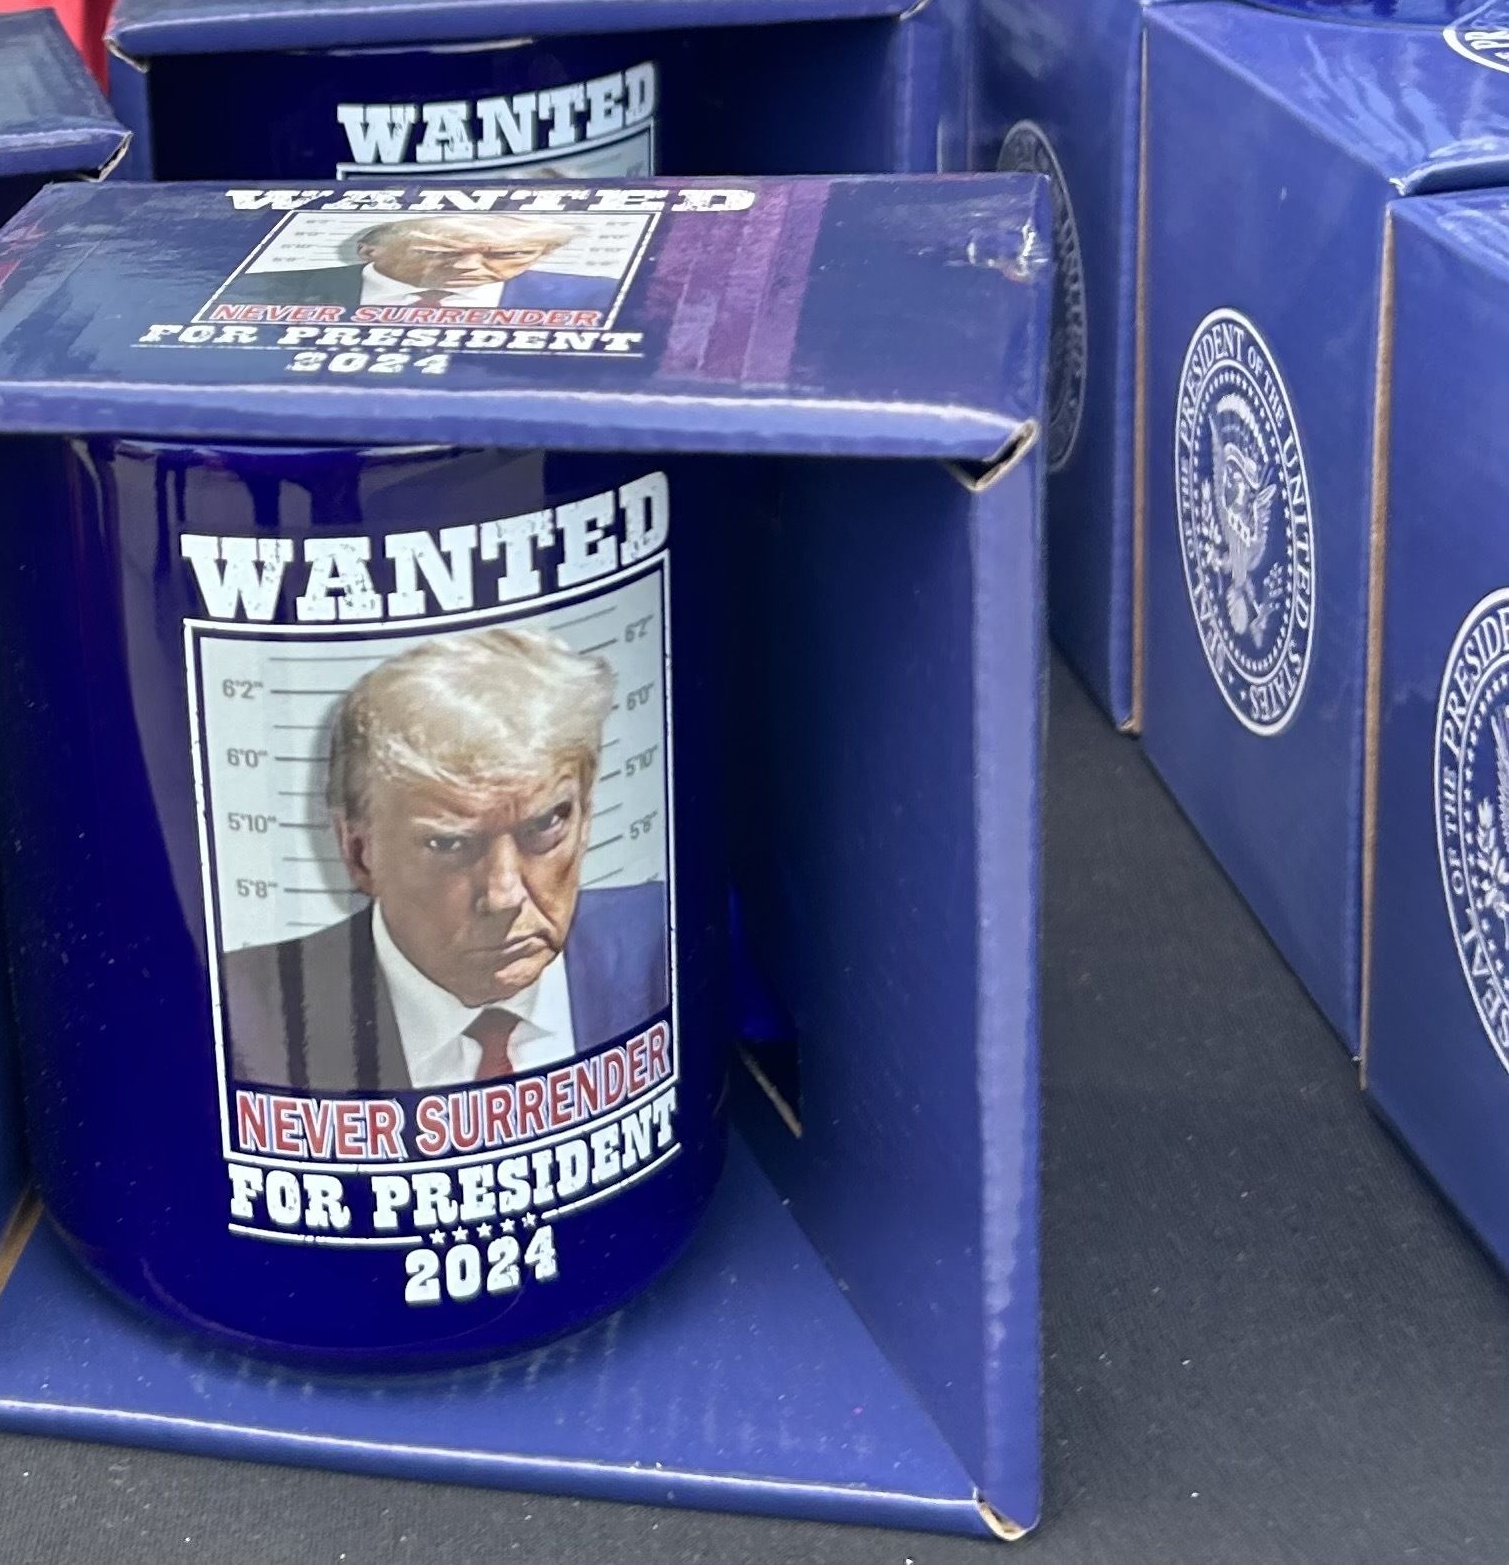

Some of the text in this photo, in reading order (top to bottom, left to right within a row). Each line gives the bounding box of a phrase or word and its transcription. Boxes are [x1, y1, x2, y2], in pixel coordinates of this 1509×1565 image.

[336, 60, 657, 165] WANTED
[225, 188, 756, 212] WANTED
[140, 323, 644, 354] FOR PRESIDENT
[209, 303, 604, 327] NEVER SURRENDER
[285, 350, 452, 375] 2024
[1181, 322, 1246, 451] PRESIDENT
[1247, 345, 1266, 377] OF
[1264, 370, 1286, 428] THE
[1282, 430, 1310, 630] UNITED
[181, 471, 670, 622] WANTED
[234, 1019, 674, 1162] NEVER SURRENDER
[227, 1087, 680, 1230] FOR PRESIDENT
[404, 1224, 561, 1307] 2024
